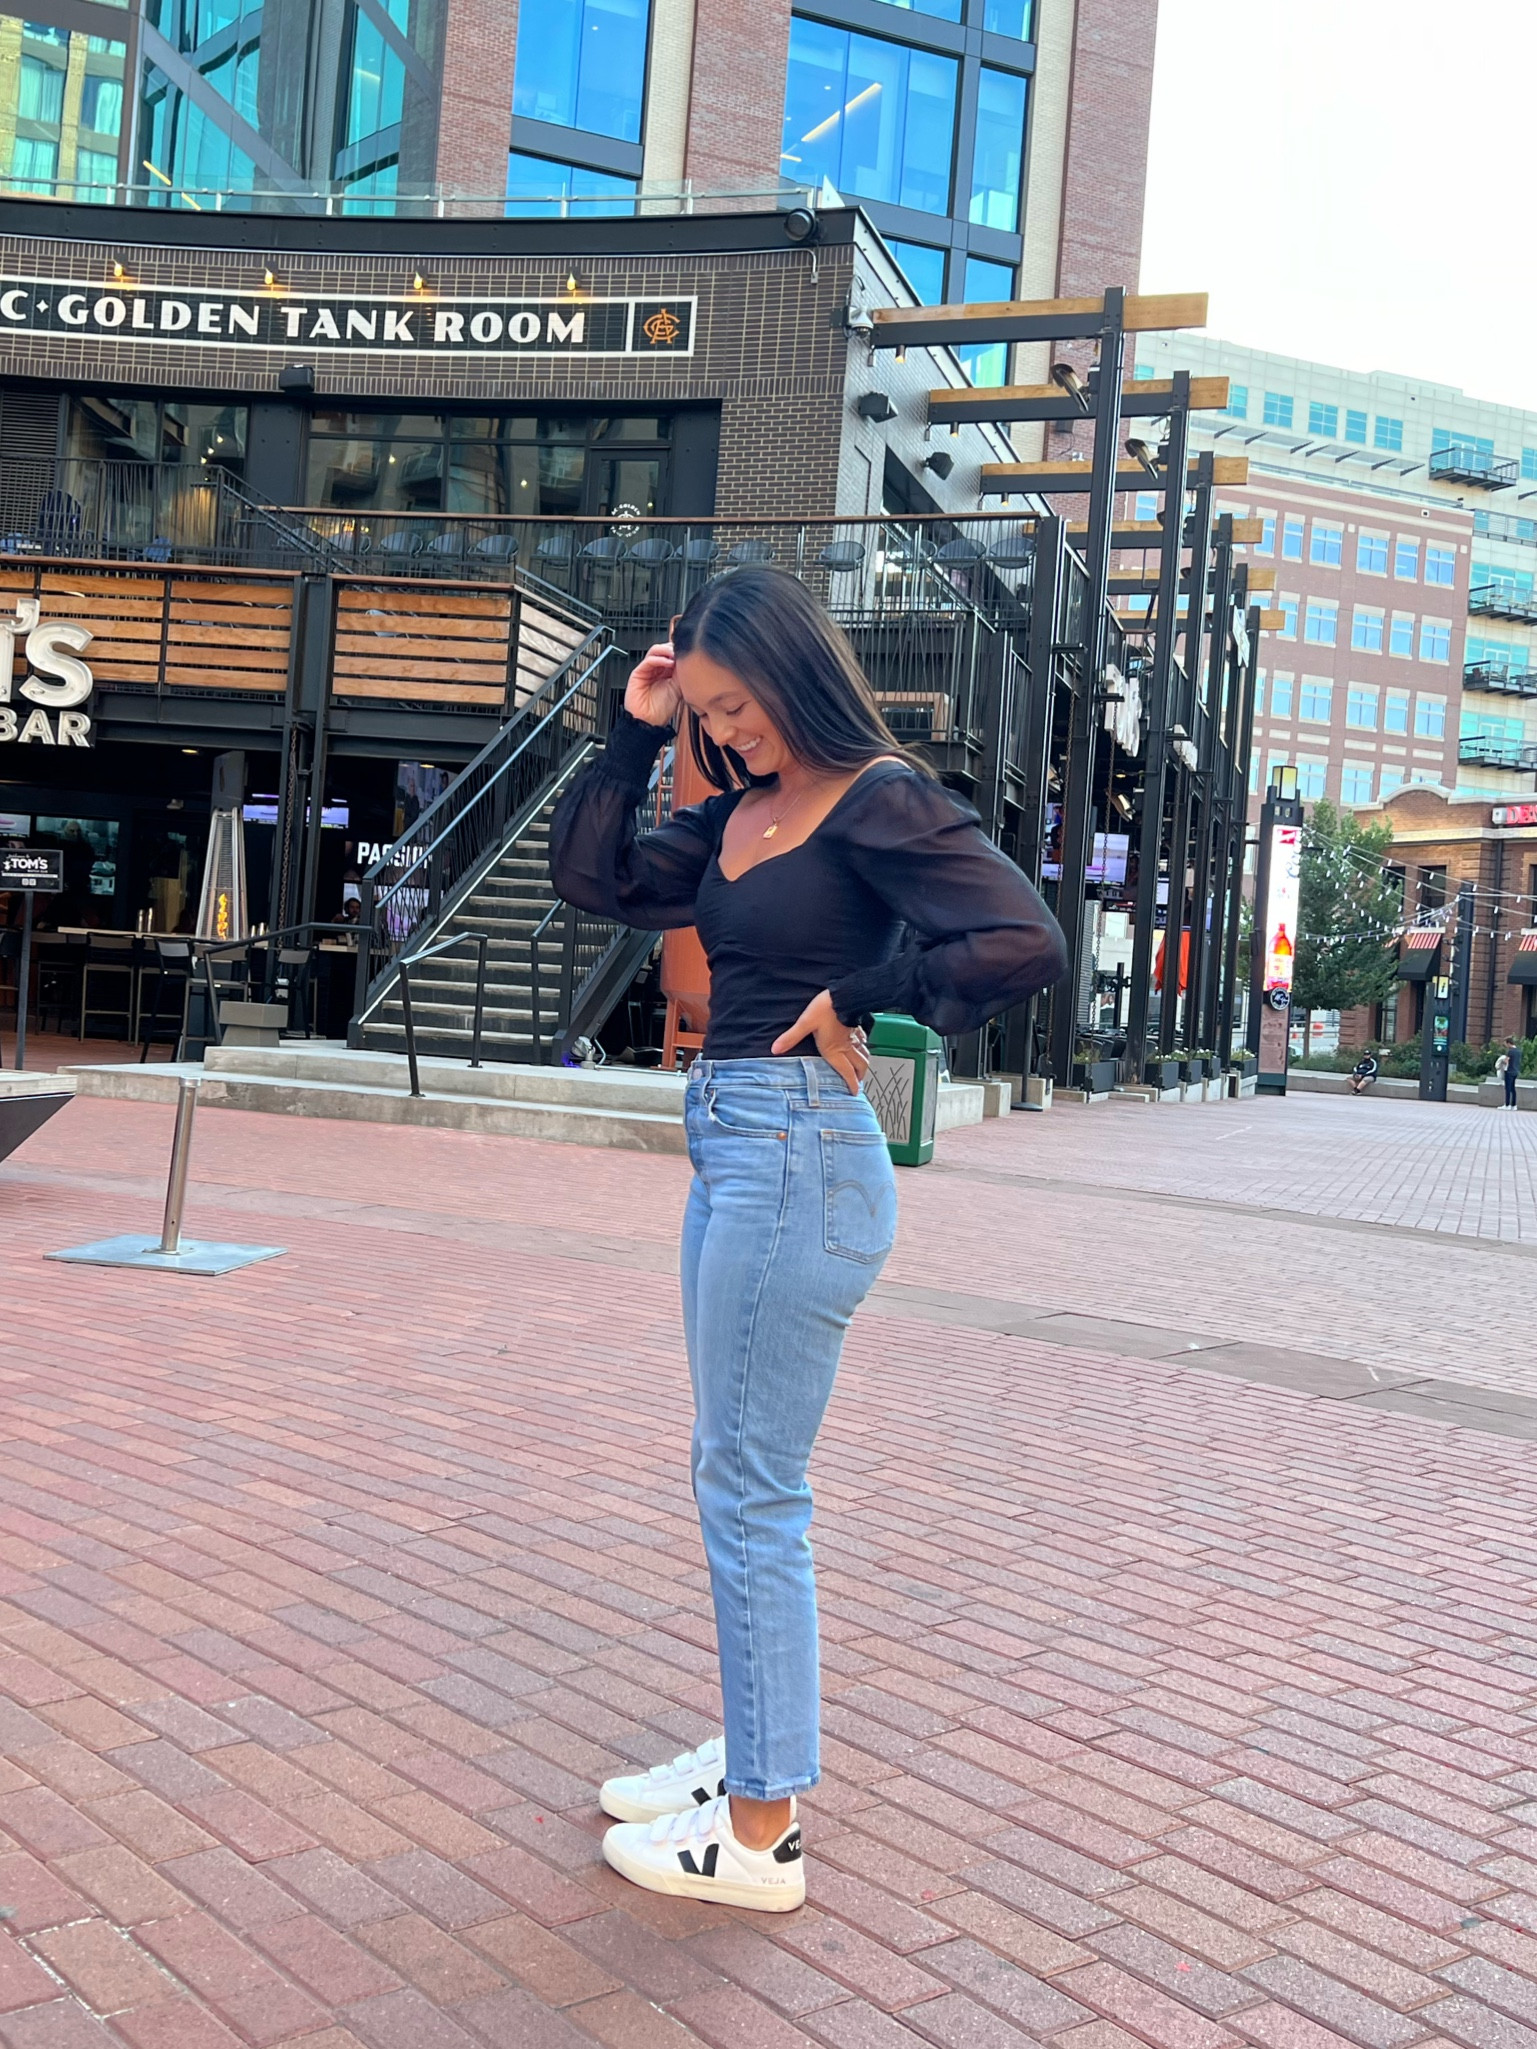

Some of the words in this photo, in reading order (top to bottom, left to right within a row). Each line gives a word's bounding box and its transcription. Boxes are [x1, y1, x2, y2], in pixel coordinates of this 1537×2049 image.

[58, 294, 260, 336] GOLDEN
[280, 307, 414, 341] TANK
[434, 311, 585, 344] ROOM
[10, 856, 48, 869] TOM'S
[787, 1839, 801, 1851] VE
[761, 1876, 786, 1885] VEJA
